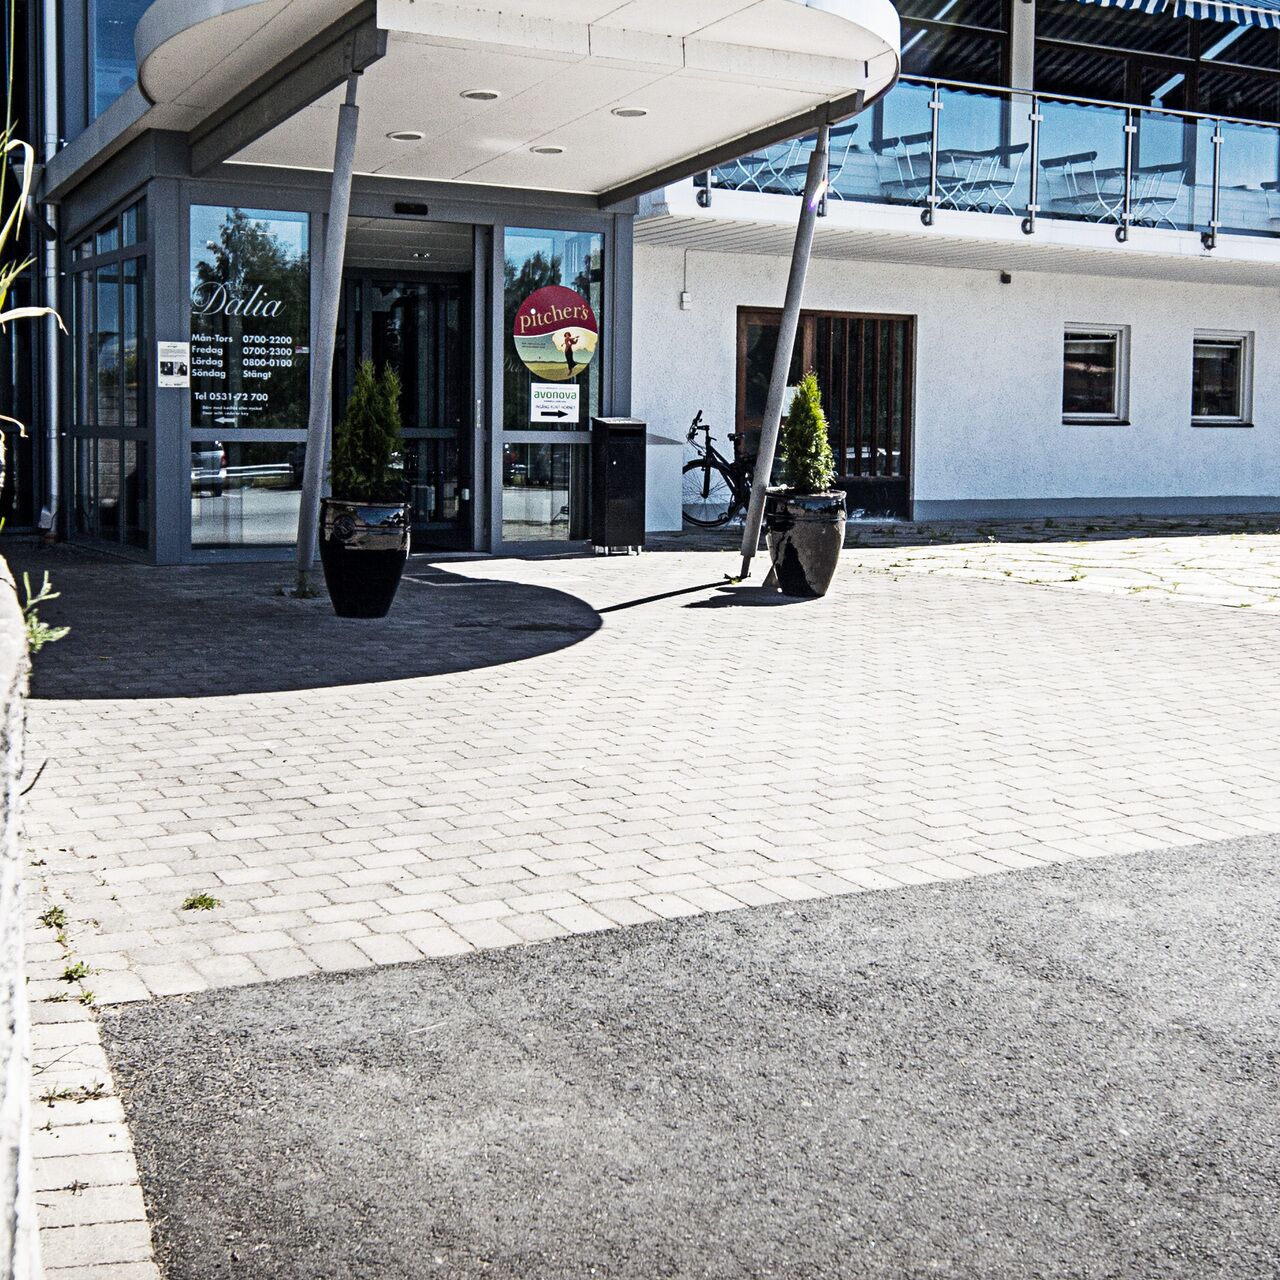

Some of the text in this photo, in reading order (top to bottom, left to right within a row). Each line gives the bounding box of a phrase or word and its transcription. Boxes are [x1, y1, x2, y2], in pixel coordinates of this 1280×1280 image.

[192, 281, 286, 318] Dalia
[520, 304, 589, 333] pitcher's
[192, 333, 292, 344] Mån-Tors 0700-2200
[192, 346, 223, 355] Fredag
[243, 347, 292, 356] 0700-2300
[192, 357, 292, 367] Lördag 0800-0100
[192, 369, 271, 380] Söndag Stängt
[195, 392, 268, 401] Tel 0531-72 700
[533, 391, 577, 400] avonova
